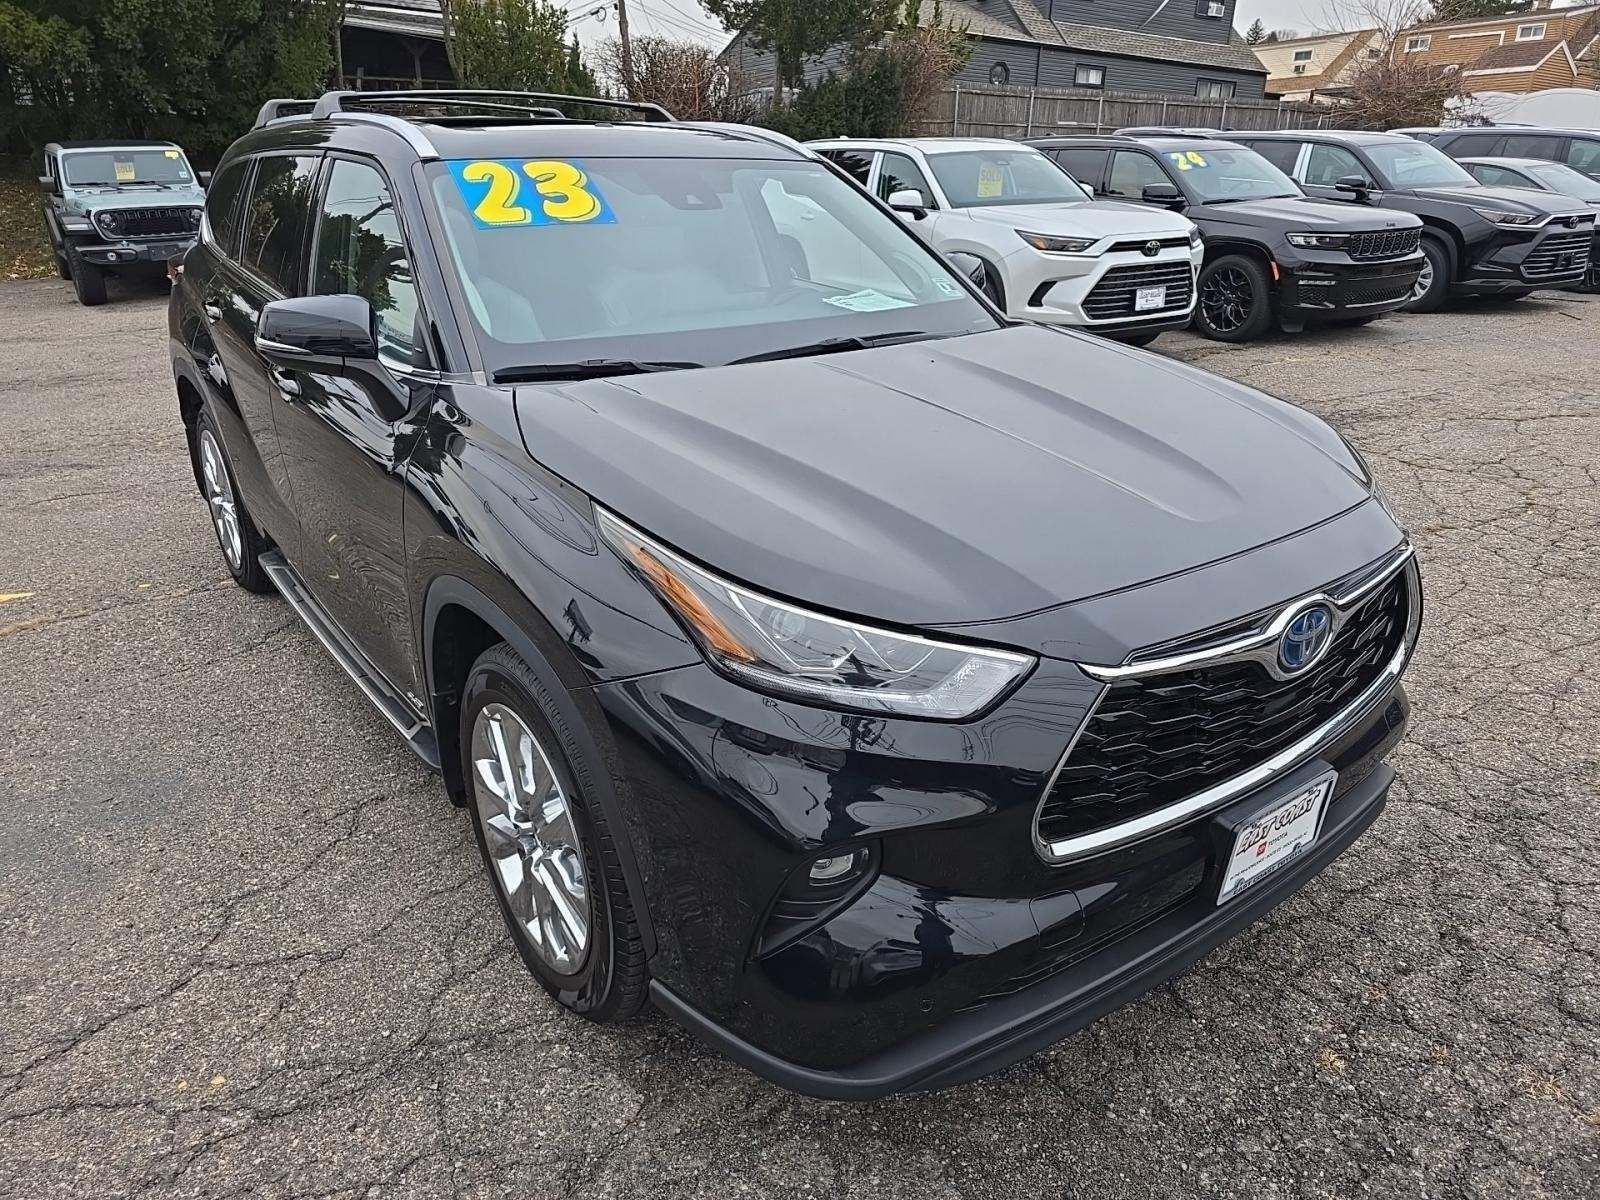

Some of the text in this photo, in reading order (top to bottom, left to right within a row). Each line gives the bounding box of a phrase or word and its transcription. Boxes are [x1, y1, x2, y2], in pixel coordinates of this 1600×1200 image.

[1170, 151, 1208, 170] 24
[980, 168, 1002, 182] SOLD
[463, 161, 602, 225] 23
[1236, 816, 1278, 856] EAST
[1275, 789, 1321, 830] COAST
[1269, 832, 1288, 846] TOYOTA
